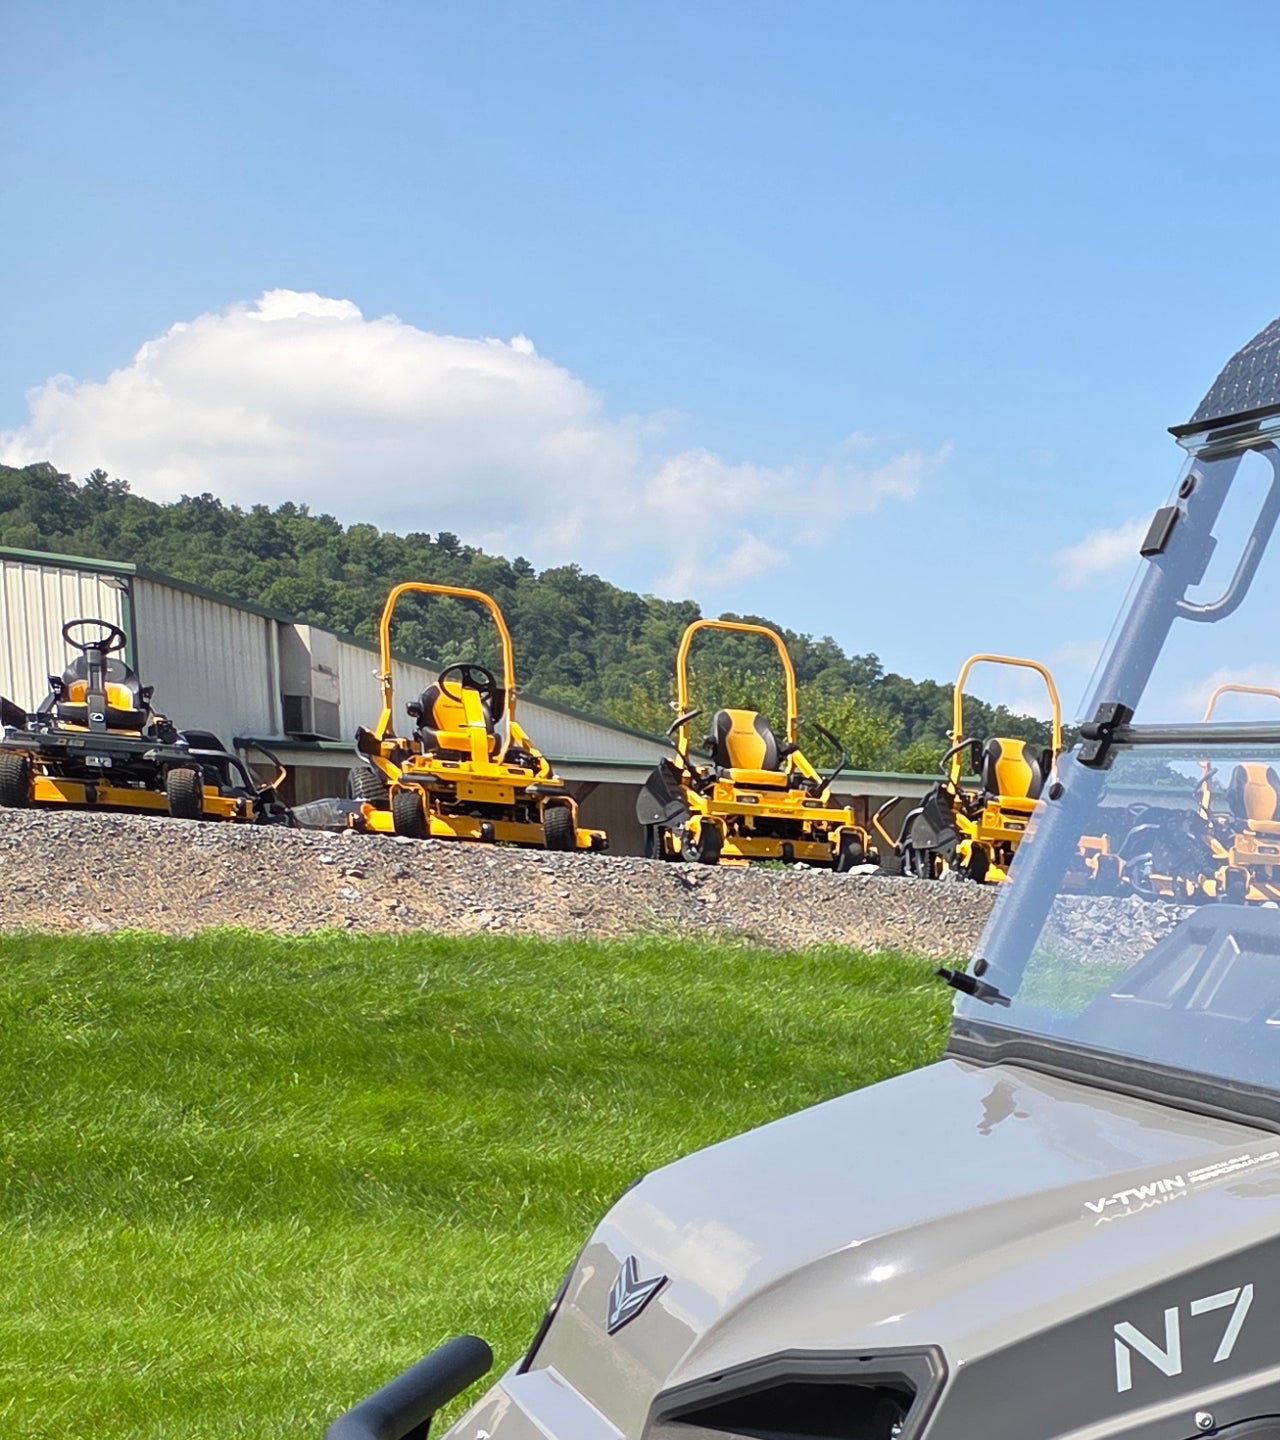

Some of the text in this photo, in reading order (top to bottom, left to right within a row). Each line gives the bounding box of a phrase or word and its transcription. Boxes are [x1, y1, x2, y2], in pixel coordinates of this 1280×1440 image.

[1084, 1151, 1280, 1214] V-TWIN PERFORMANCE
[1113, 1283, 1254, 1393] N7
